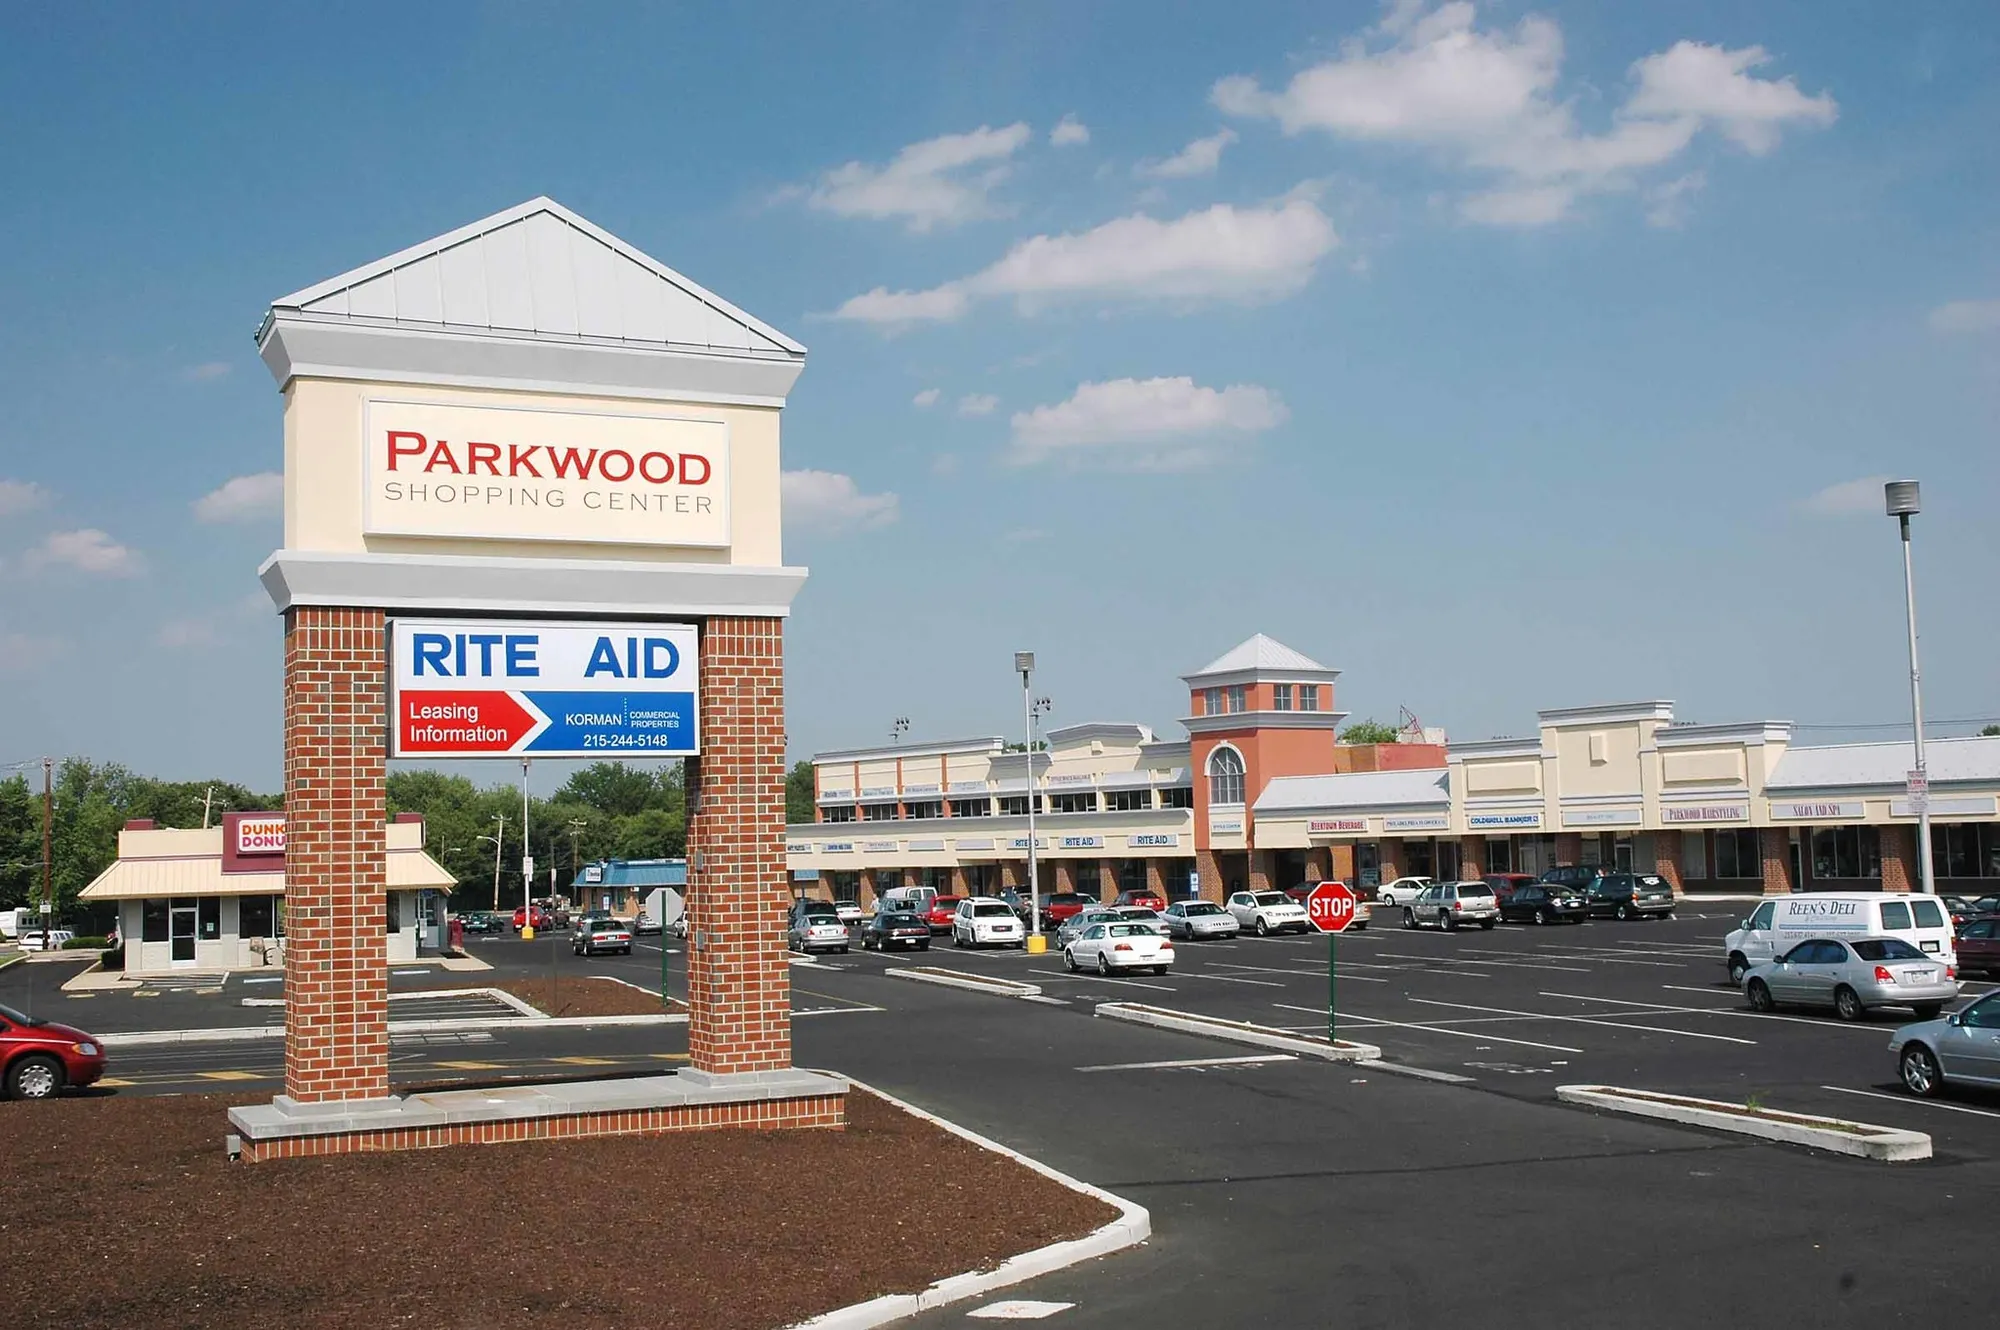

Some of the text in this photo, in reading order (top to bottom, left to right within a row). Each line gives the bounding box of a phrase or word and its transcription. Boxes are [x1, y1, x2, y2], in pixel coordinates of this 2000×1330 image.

[386, 430, 712, 485] PARKWOOD
[384, 482, 713, 514] SHOPPING CENTER
[412, 633, 680, 679] RITE AID
[409, 702, 479, 724] Leasing
[565, 713, 622, 727] KORMAN
[629, 710, 681, 720] COMMERCIAL
[630, 719, 680, 729] PROPERTIES
[409, 725, 508, 743] Information
[583, 734, 669, 747] 215-244-5148
[1792, 805, 1813, 816] SALON
[1828, 804, 1841, 815] SPA
[1015, 839, 1028, 847] RITE
[1065, 836, 1094, 846] RITE AID
[1137, 835, 1168, 845] RITE AID
[1311, 897, 1353, 917] STOP
[1789, 900, 1857, 915] REEN'S DELI
